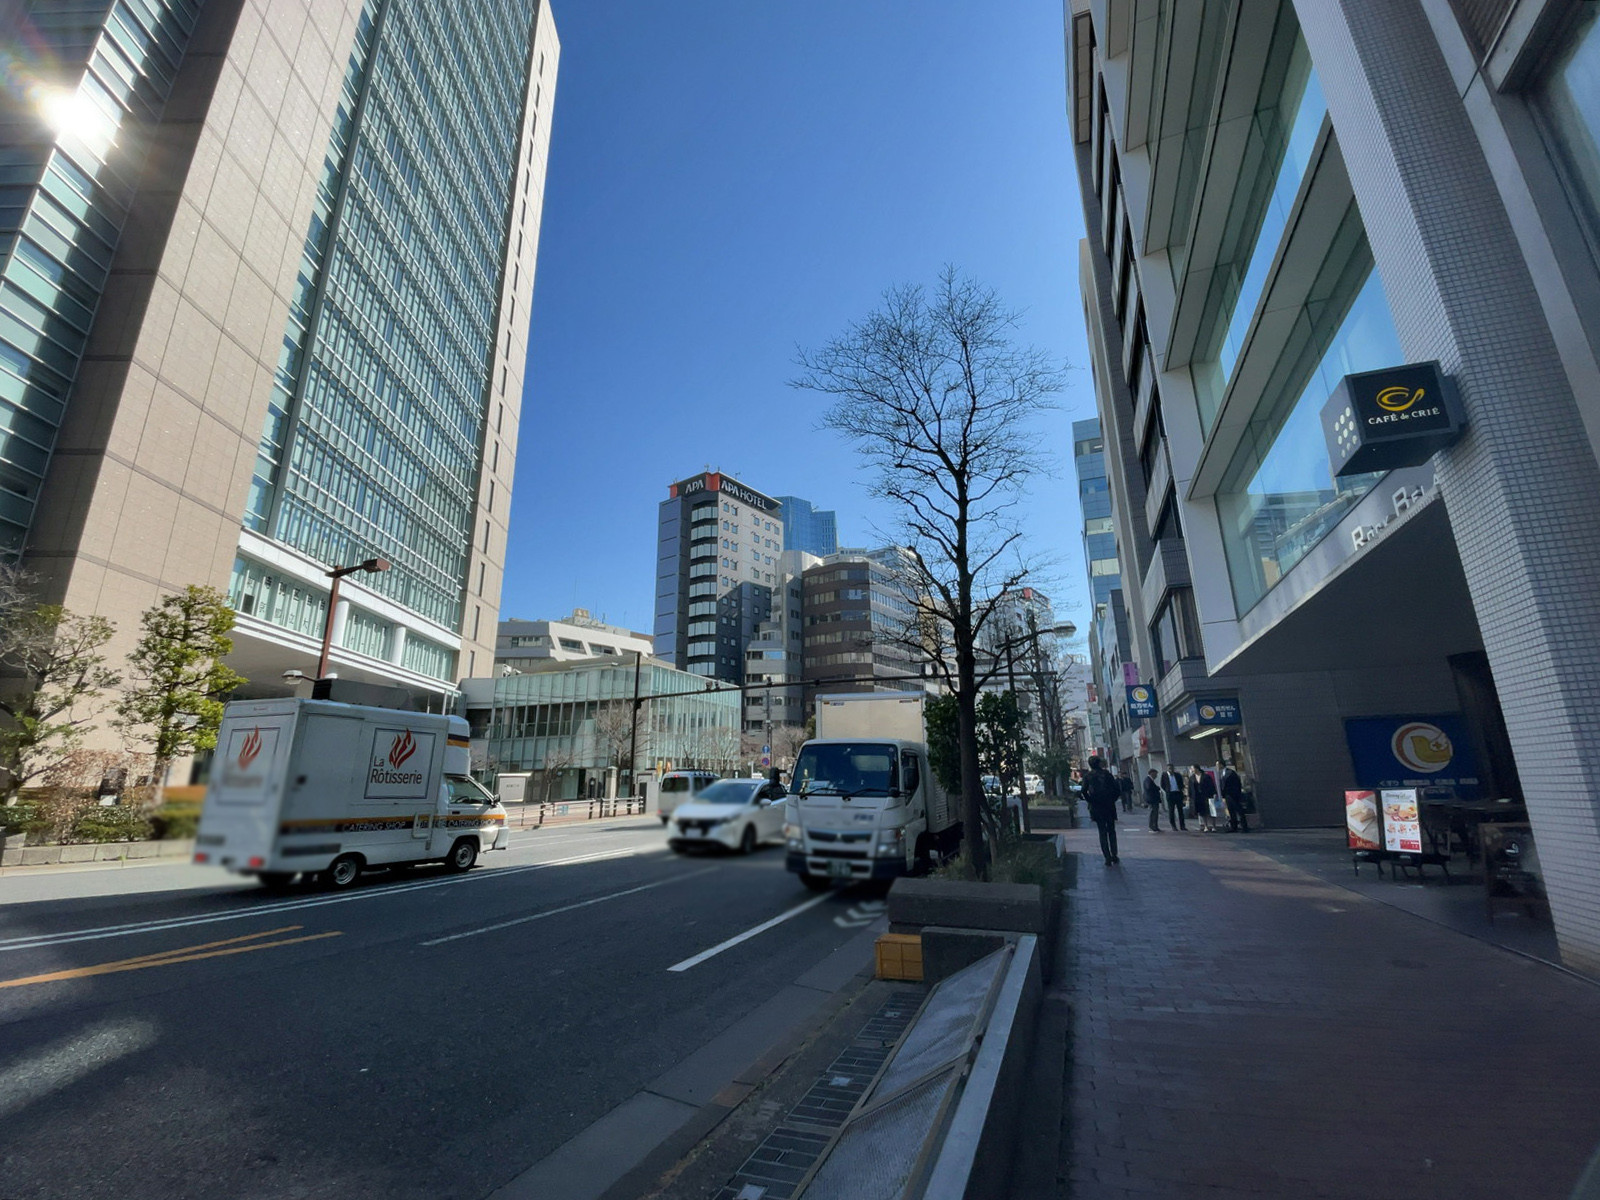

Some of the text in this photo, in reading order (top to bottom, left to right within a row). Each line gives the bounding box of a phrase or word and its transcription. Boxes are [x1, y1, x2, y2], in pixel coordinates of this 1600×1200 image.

[685, 479, 704, 494] APA
[721, 480, 767, 510] APA HOTEL
[373, 755, 384, 767] La
[370, 768, 423, 786] Rôtisserie
[342, 822, 385, 832] CATERING
[385, 821, 406, 831] SHOP
